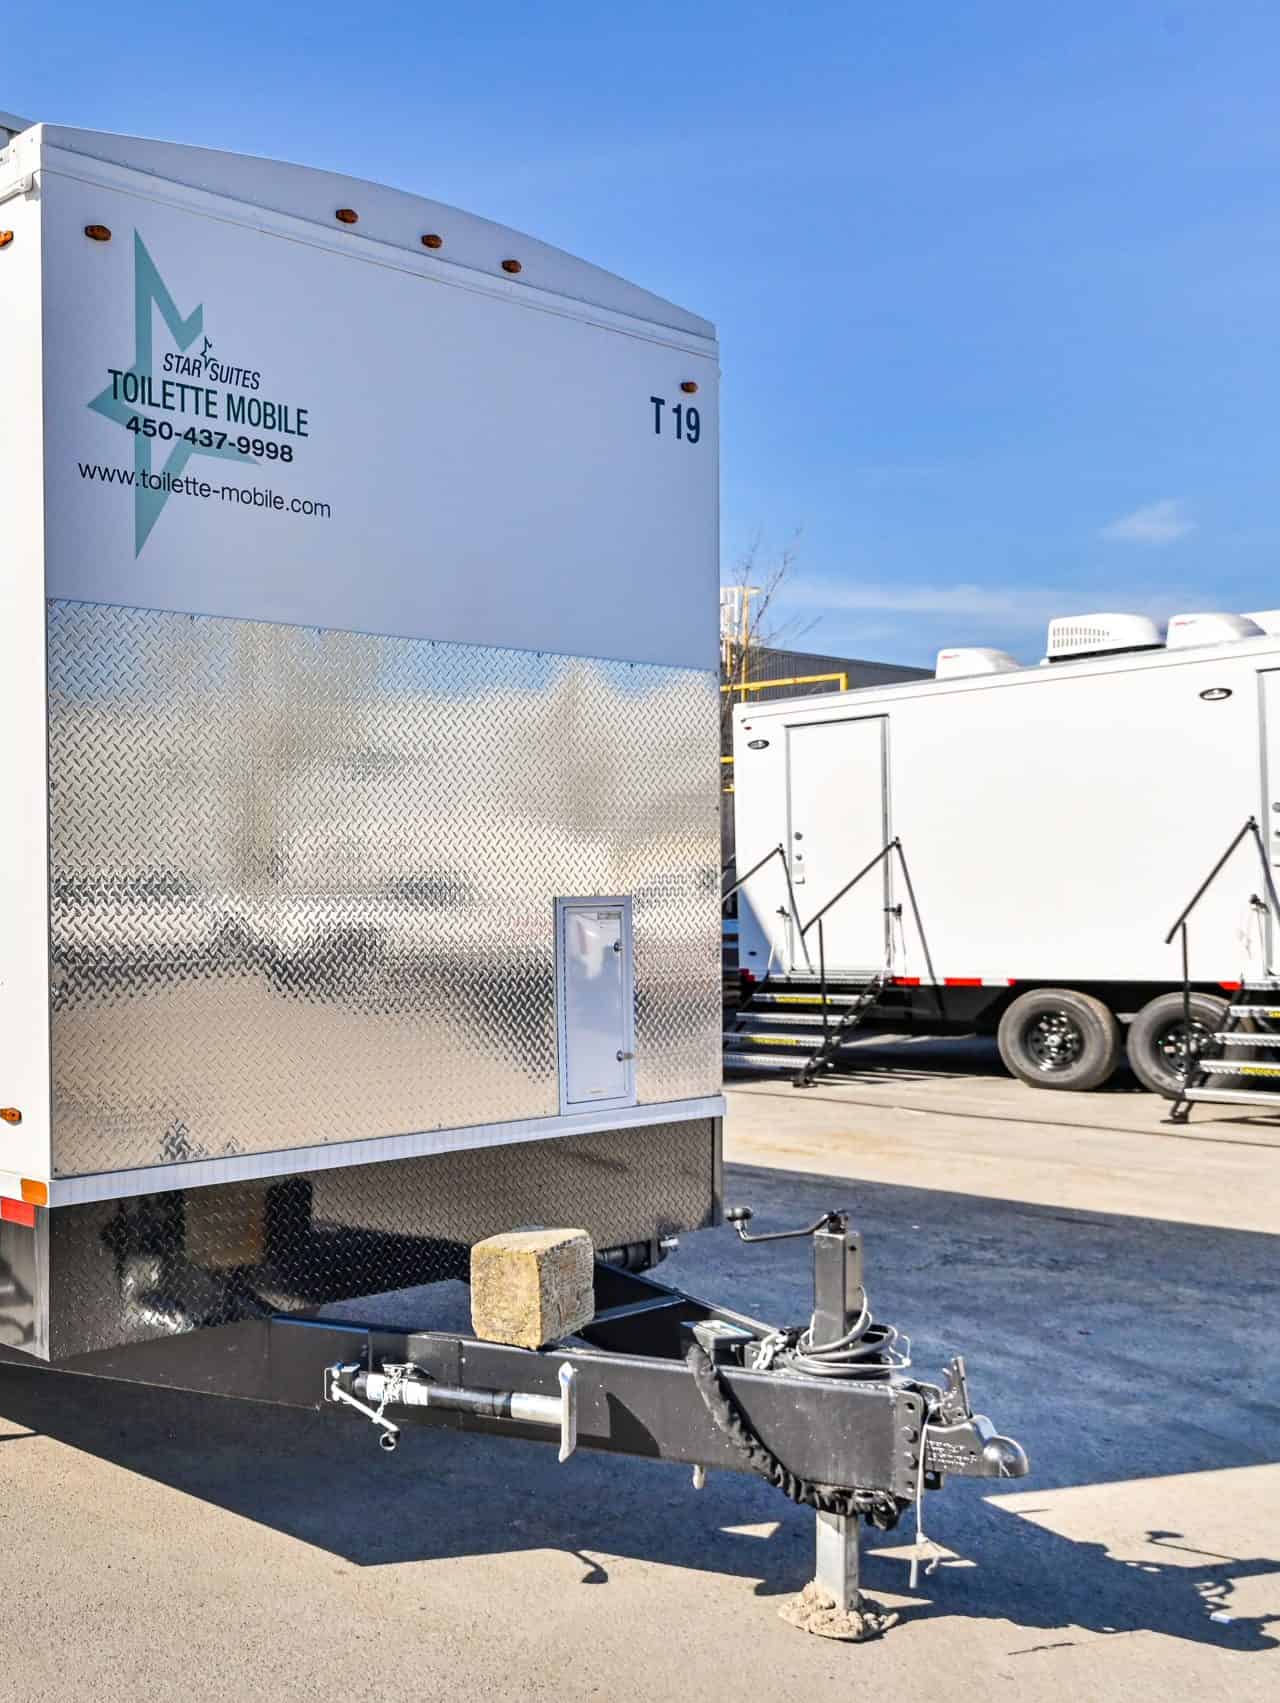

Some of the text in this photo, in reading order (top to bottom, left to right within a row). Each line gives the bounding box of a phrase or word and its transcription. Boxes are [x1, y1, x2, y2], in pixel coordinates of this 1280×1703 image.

[162, 352, 261, 390] STAR SUITES
[107, 368, 309, 437] TOILETTE MOBILE
[125, 416, 294, 463] 450-437-9998
[77, 462, 331, 518] www.toilette-mobile.com
